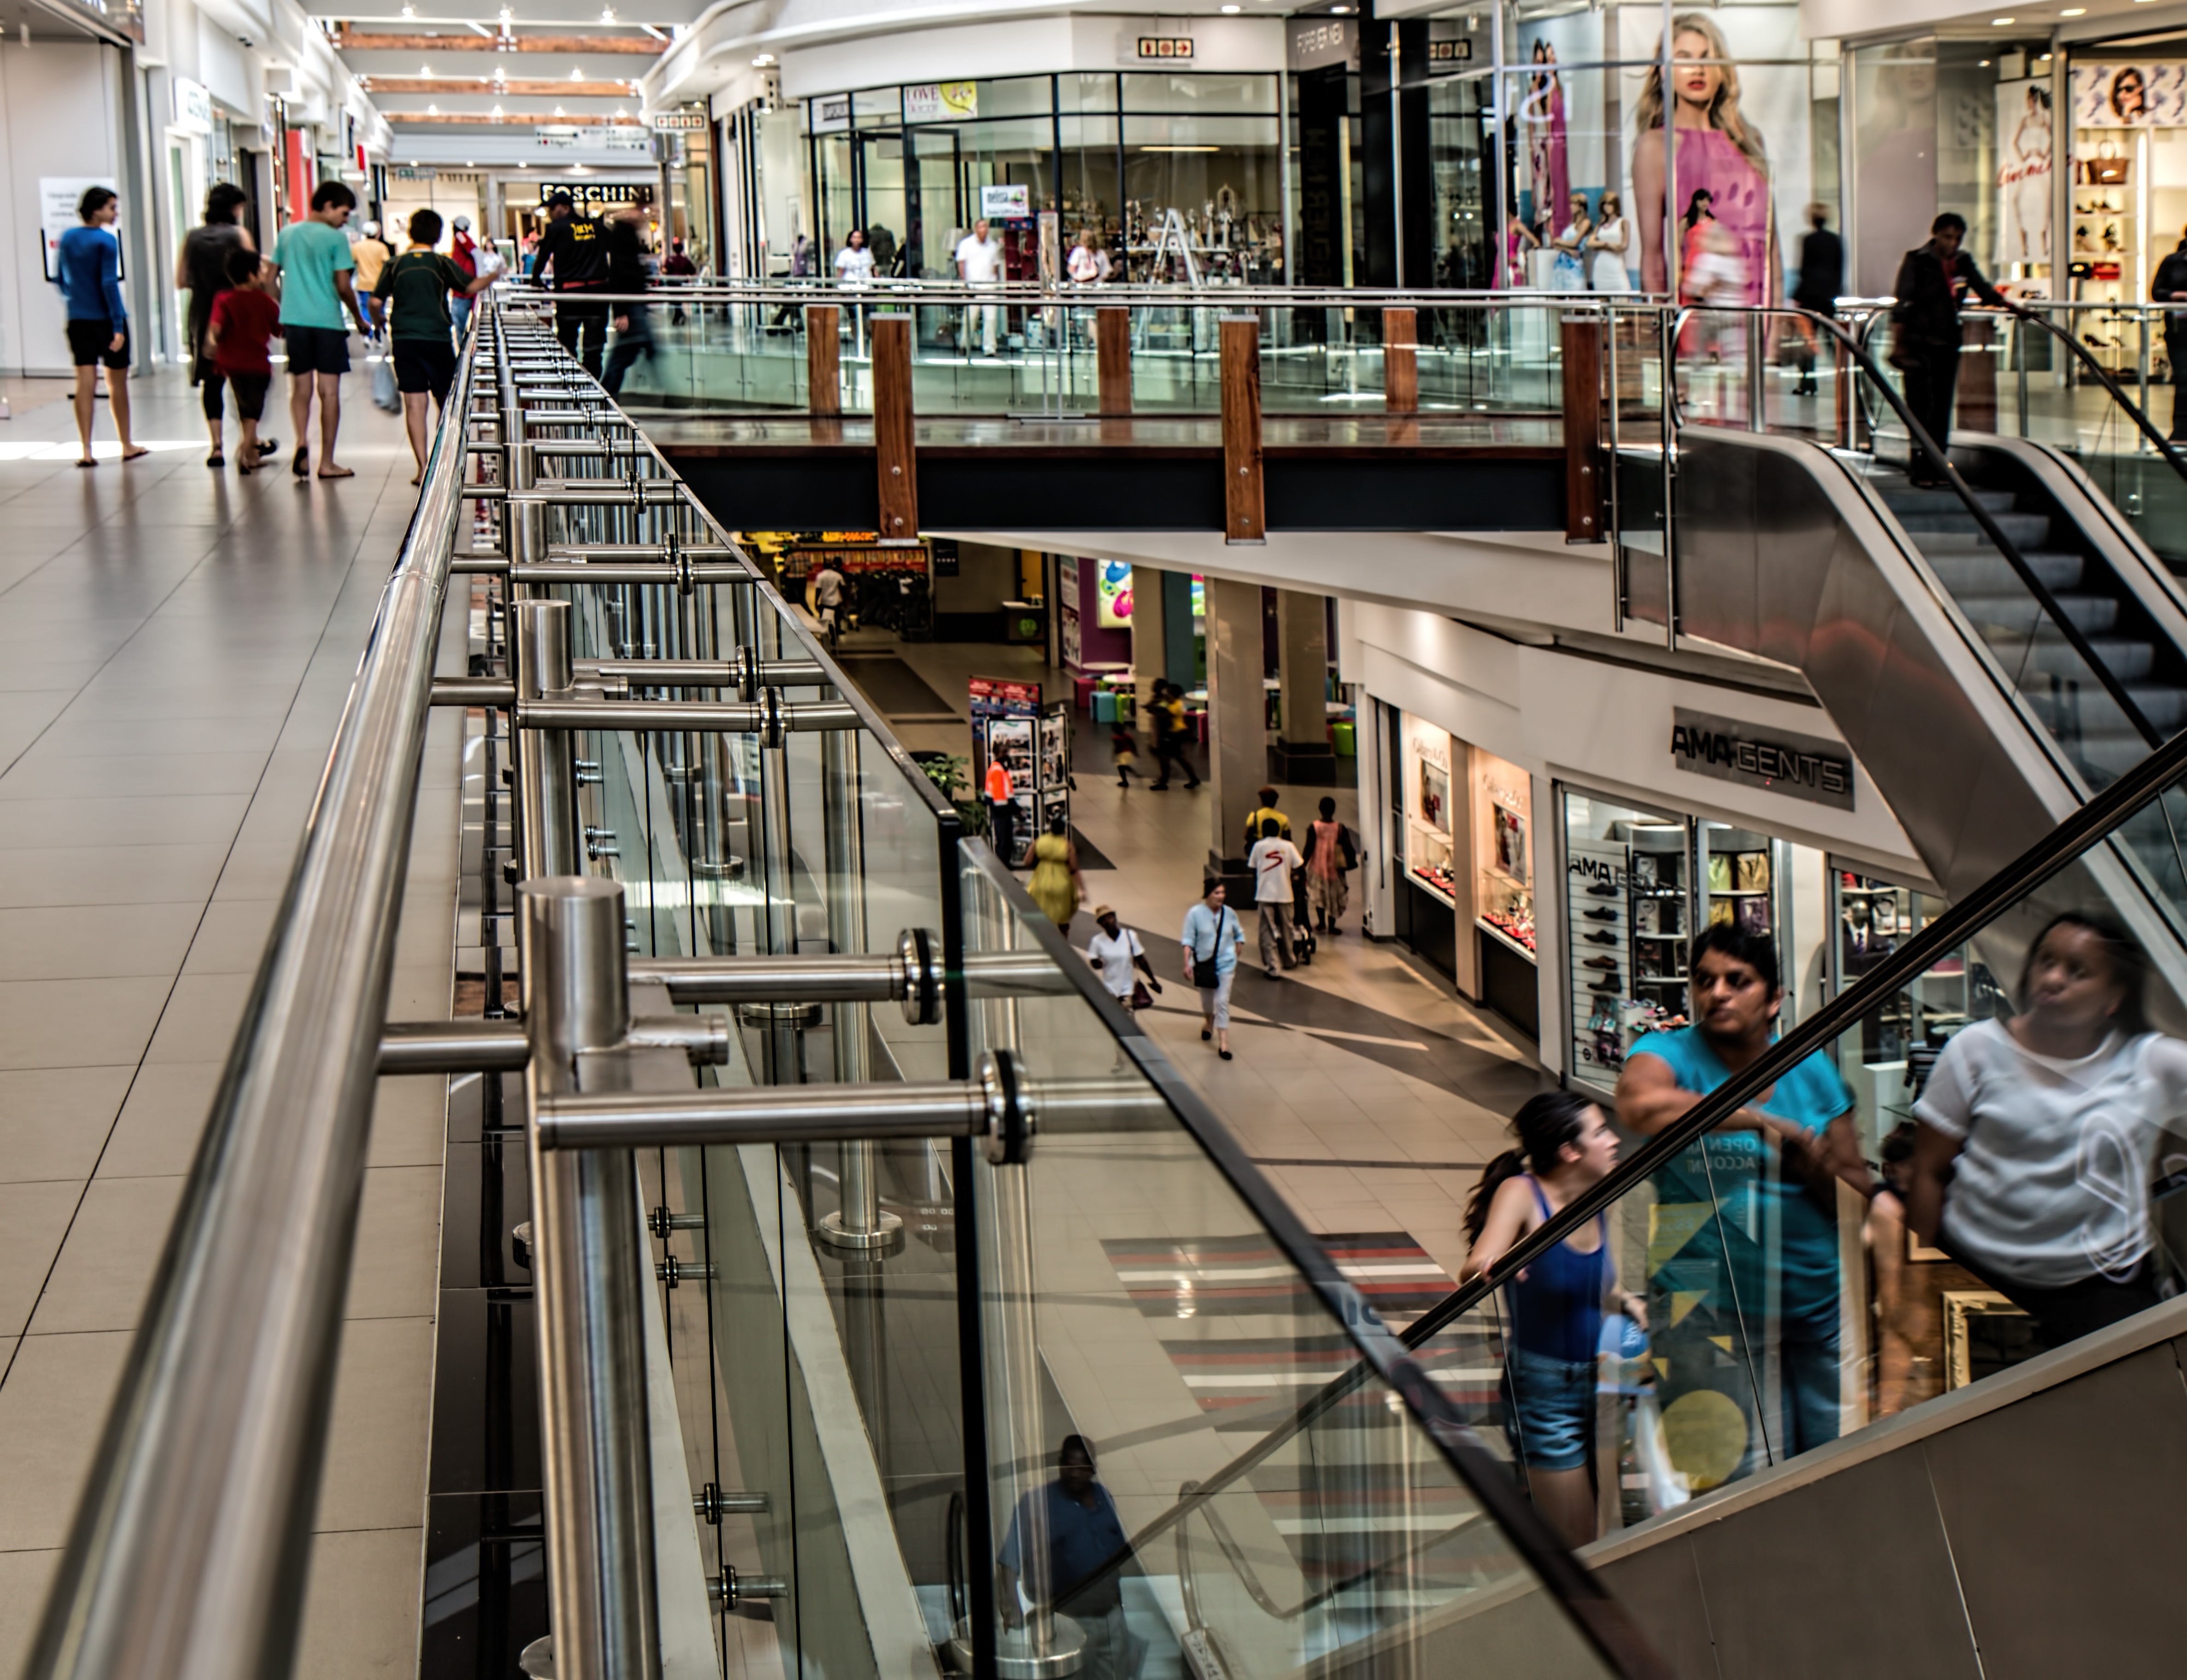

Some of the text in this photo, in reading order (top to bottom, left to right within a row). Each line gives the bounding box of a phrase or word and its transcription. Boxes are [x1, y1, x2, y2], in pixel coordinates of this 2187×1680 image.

[906, 86, 938, 102] LOVE
[542, 184, 650, 202] FOSCHINI
[1670, 725, 1846, 794] AMA GENTS
[1569, 857, 1612, 885] AMA
